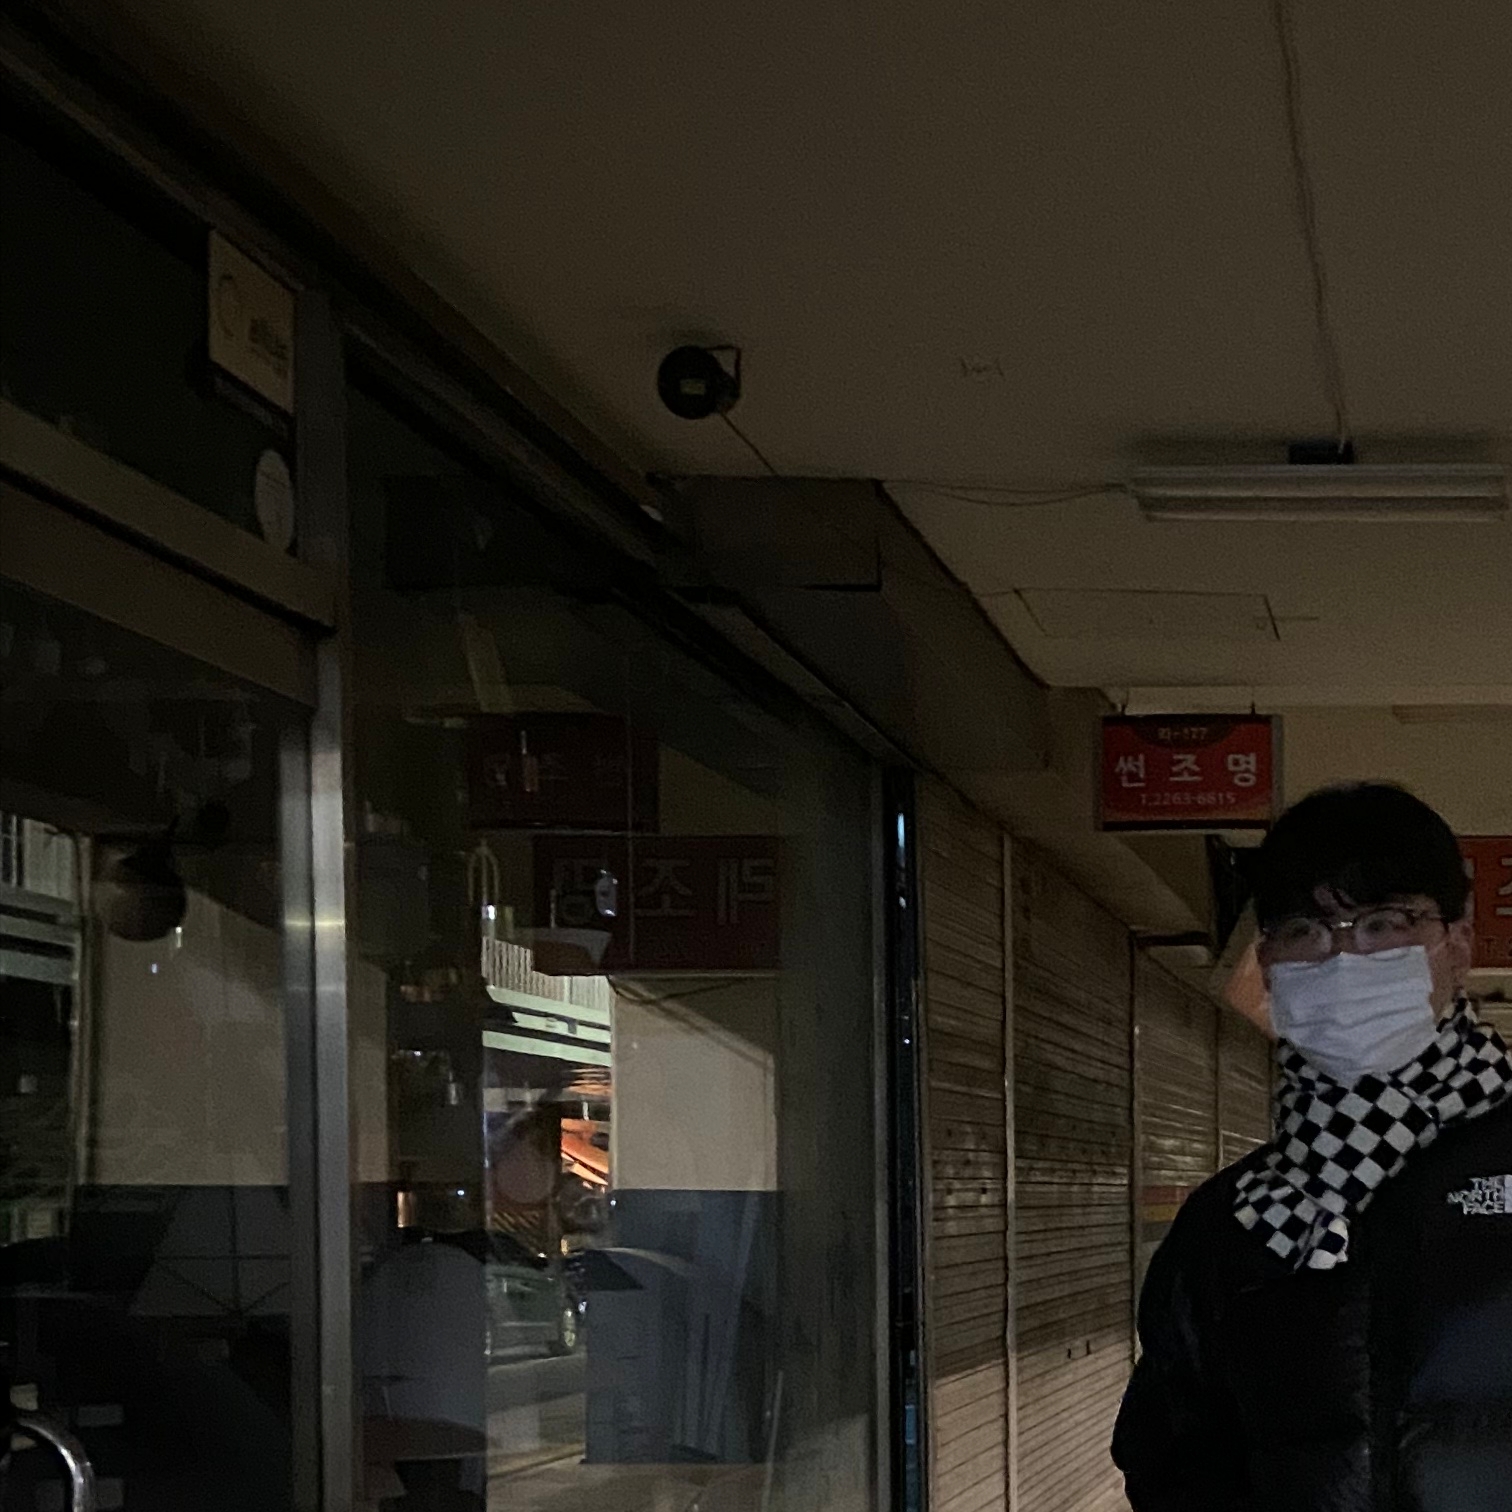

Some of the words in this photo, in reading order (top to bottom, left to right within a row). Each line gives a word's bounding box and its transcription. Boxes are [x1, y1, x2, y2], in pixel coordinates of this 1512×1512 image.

[1469, 1176, 1504, 1190] THE
[1446, 1187, 1504, 1204] NORTH
[1462, 1201, 1504, 1215] FACE
